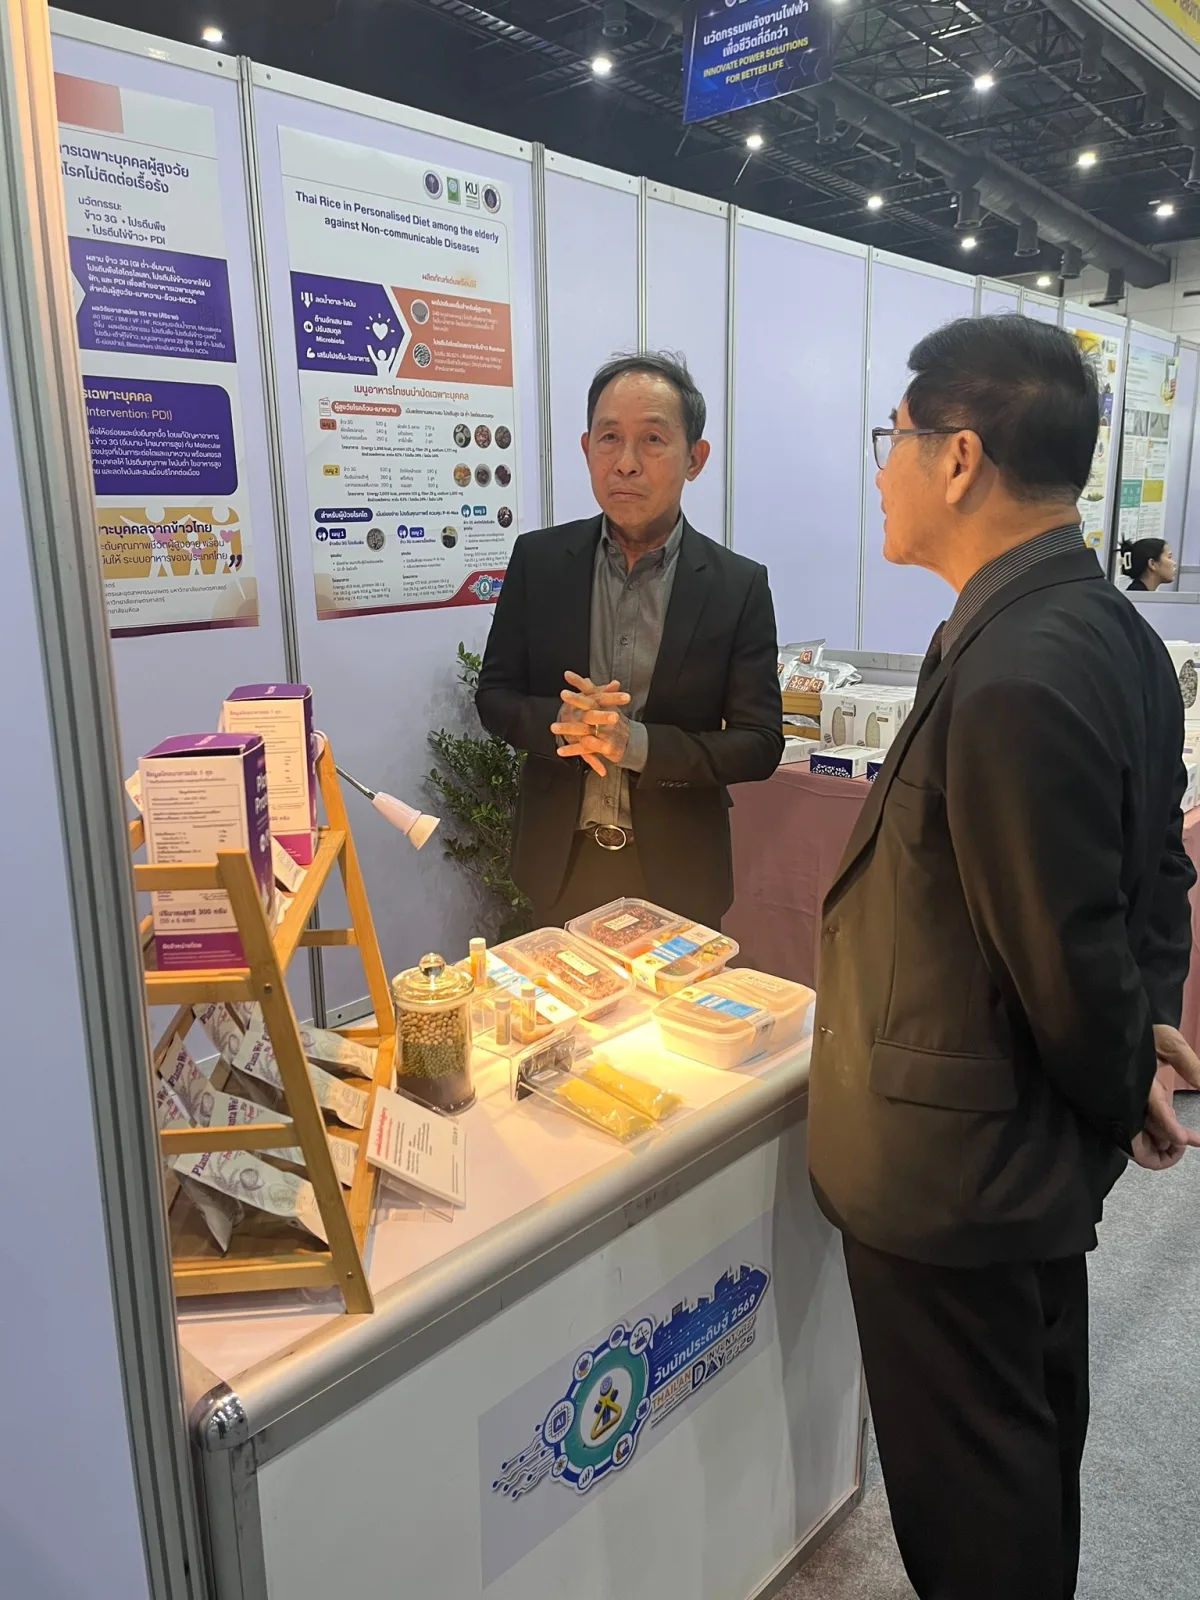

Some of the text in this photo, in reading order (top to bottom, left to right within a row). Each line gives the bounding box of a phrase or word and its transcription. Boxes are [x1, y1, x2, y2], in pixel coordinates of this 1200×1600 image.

[703, 1, 809, 45] นวัตกรรมพลังงานไฟฟ้า
[722, 25, 788, 57] เพื่อชีวิตที่ดีกว่า
[703, 37, 808, 77] INNOVATE POWER SOLUTIONS
[725, 59, 784, 84] FOR BETTER LIFE
[59, 143, 189, 177] ารเฉพาะบุคคลผู้สูงวัย
[61, 160, 169, 193] โรคไม่ติดต่อเรื้อรัง
[465, 180, 478, 195] KU
[78, 196, 122, 211] นวัตกรรม:
[84, 209, 102, 221] ข้าว
[104, 214, 117, 224] 3G
[127, 216, 166, 232] โปรตีนพืช
[296, 190, 499, 244] Thai Rice in Personalised Diet among the elderly
[150, 235, 166, 244] PDI
[324, 215, 480, 254] against Non-communicable Diseases
[152, 409, 173, 421] PDI)
[99, 520, 213, 538] าะบุคคลจากข้าวไทย
[731, 1294, 756, 1322] 2569
[555, 1415, 566, 1427] AI
